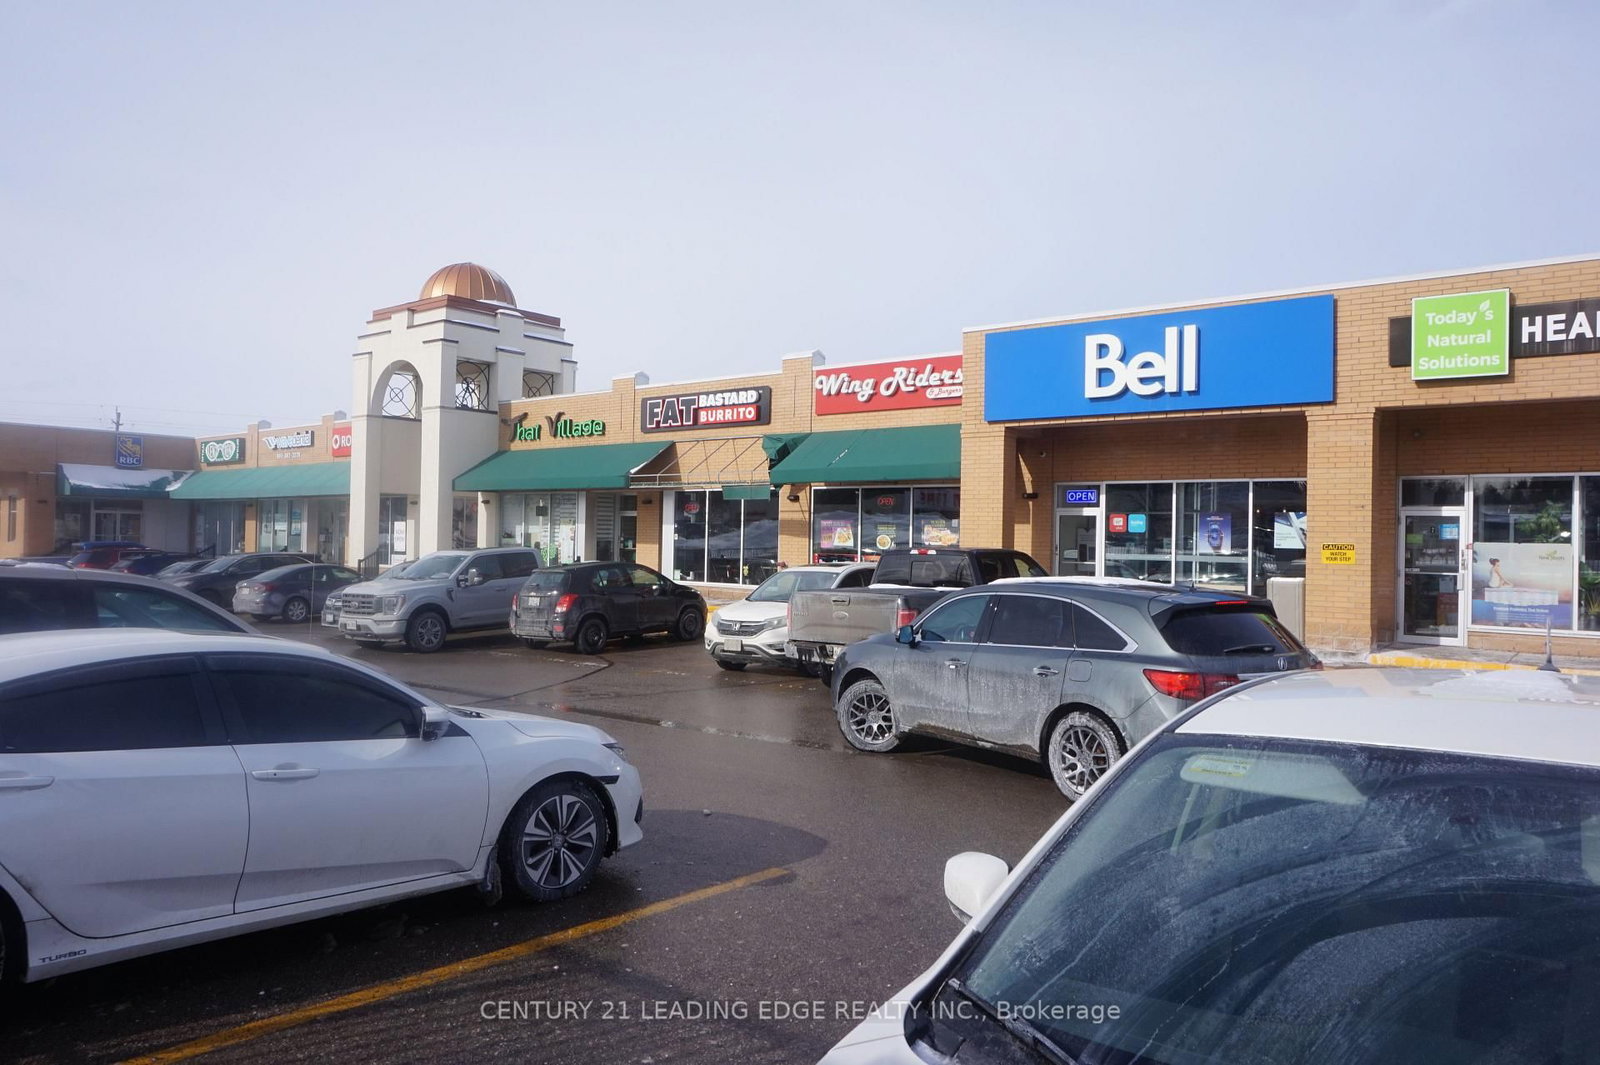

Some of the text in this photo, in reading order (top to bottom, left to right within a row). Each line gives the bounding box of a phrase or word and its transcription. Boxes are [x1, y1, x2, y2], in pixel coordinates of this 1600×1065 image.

[1425, 301, 1494, 325] Today's
[1521, 310, 1600, 343] HEA
[1427, 330, 1491, 348] Natural
[1084, 324, 1199, 399] Bell
[1418, 353, 1500, 371] Solutions
[815, 364, 963, 402] Wing Riders
[698, 390, 758, 407] BASTARD
[646, 395, 699, 428] FAT
[700, 407, 755, 422] BURRITO
[501, 411, 605, 442] Thai Village
[120, 456, 140, 465] RBC
[878, 496, 894, 505] OPEN
[1068, 492, 1096, 501] OPEN
[39, 949, 87, 963] TURBO
